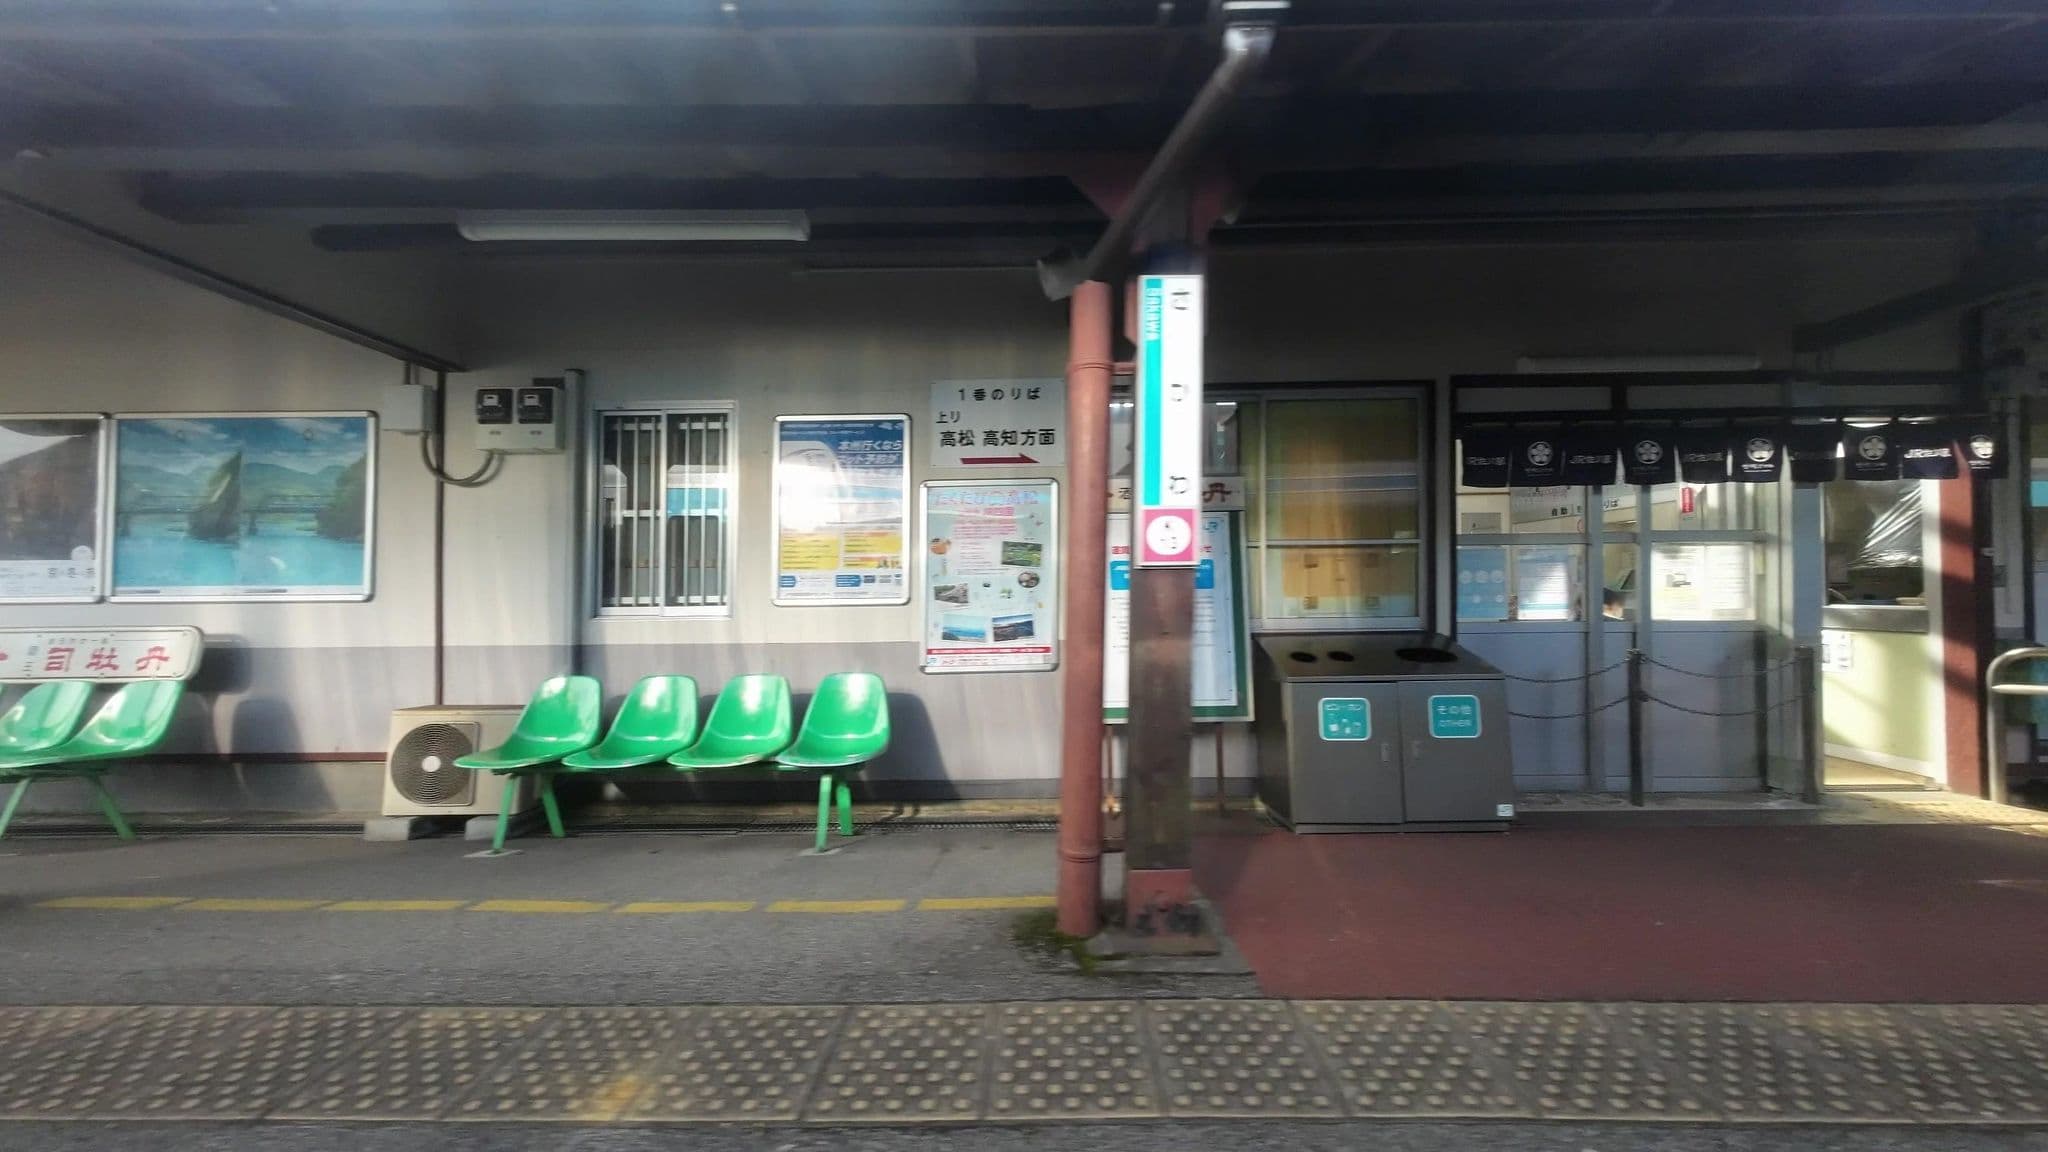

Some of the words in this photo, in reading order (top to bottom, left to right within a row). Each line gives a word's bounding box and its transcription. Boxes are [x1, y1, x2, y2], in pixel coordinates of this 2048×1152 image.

[958, 387, 1041, 401] 1番のりば
[936, 411, 960, 424] 上り
[940, 430, 975, 447] 高松
[983, 428, 1056, 447] 高知方面
